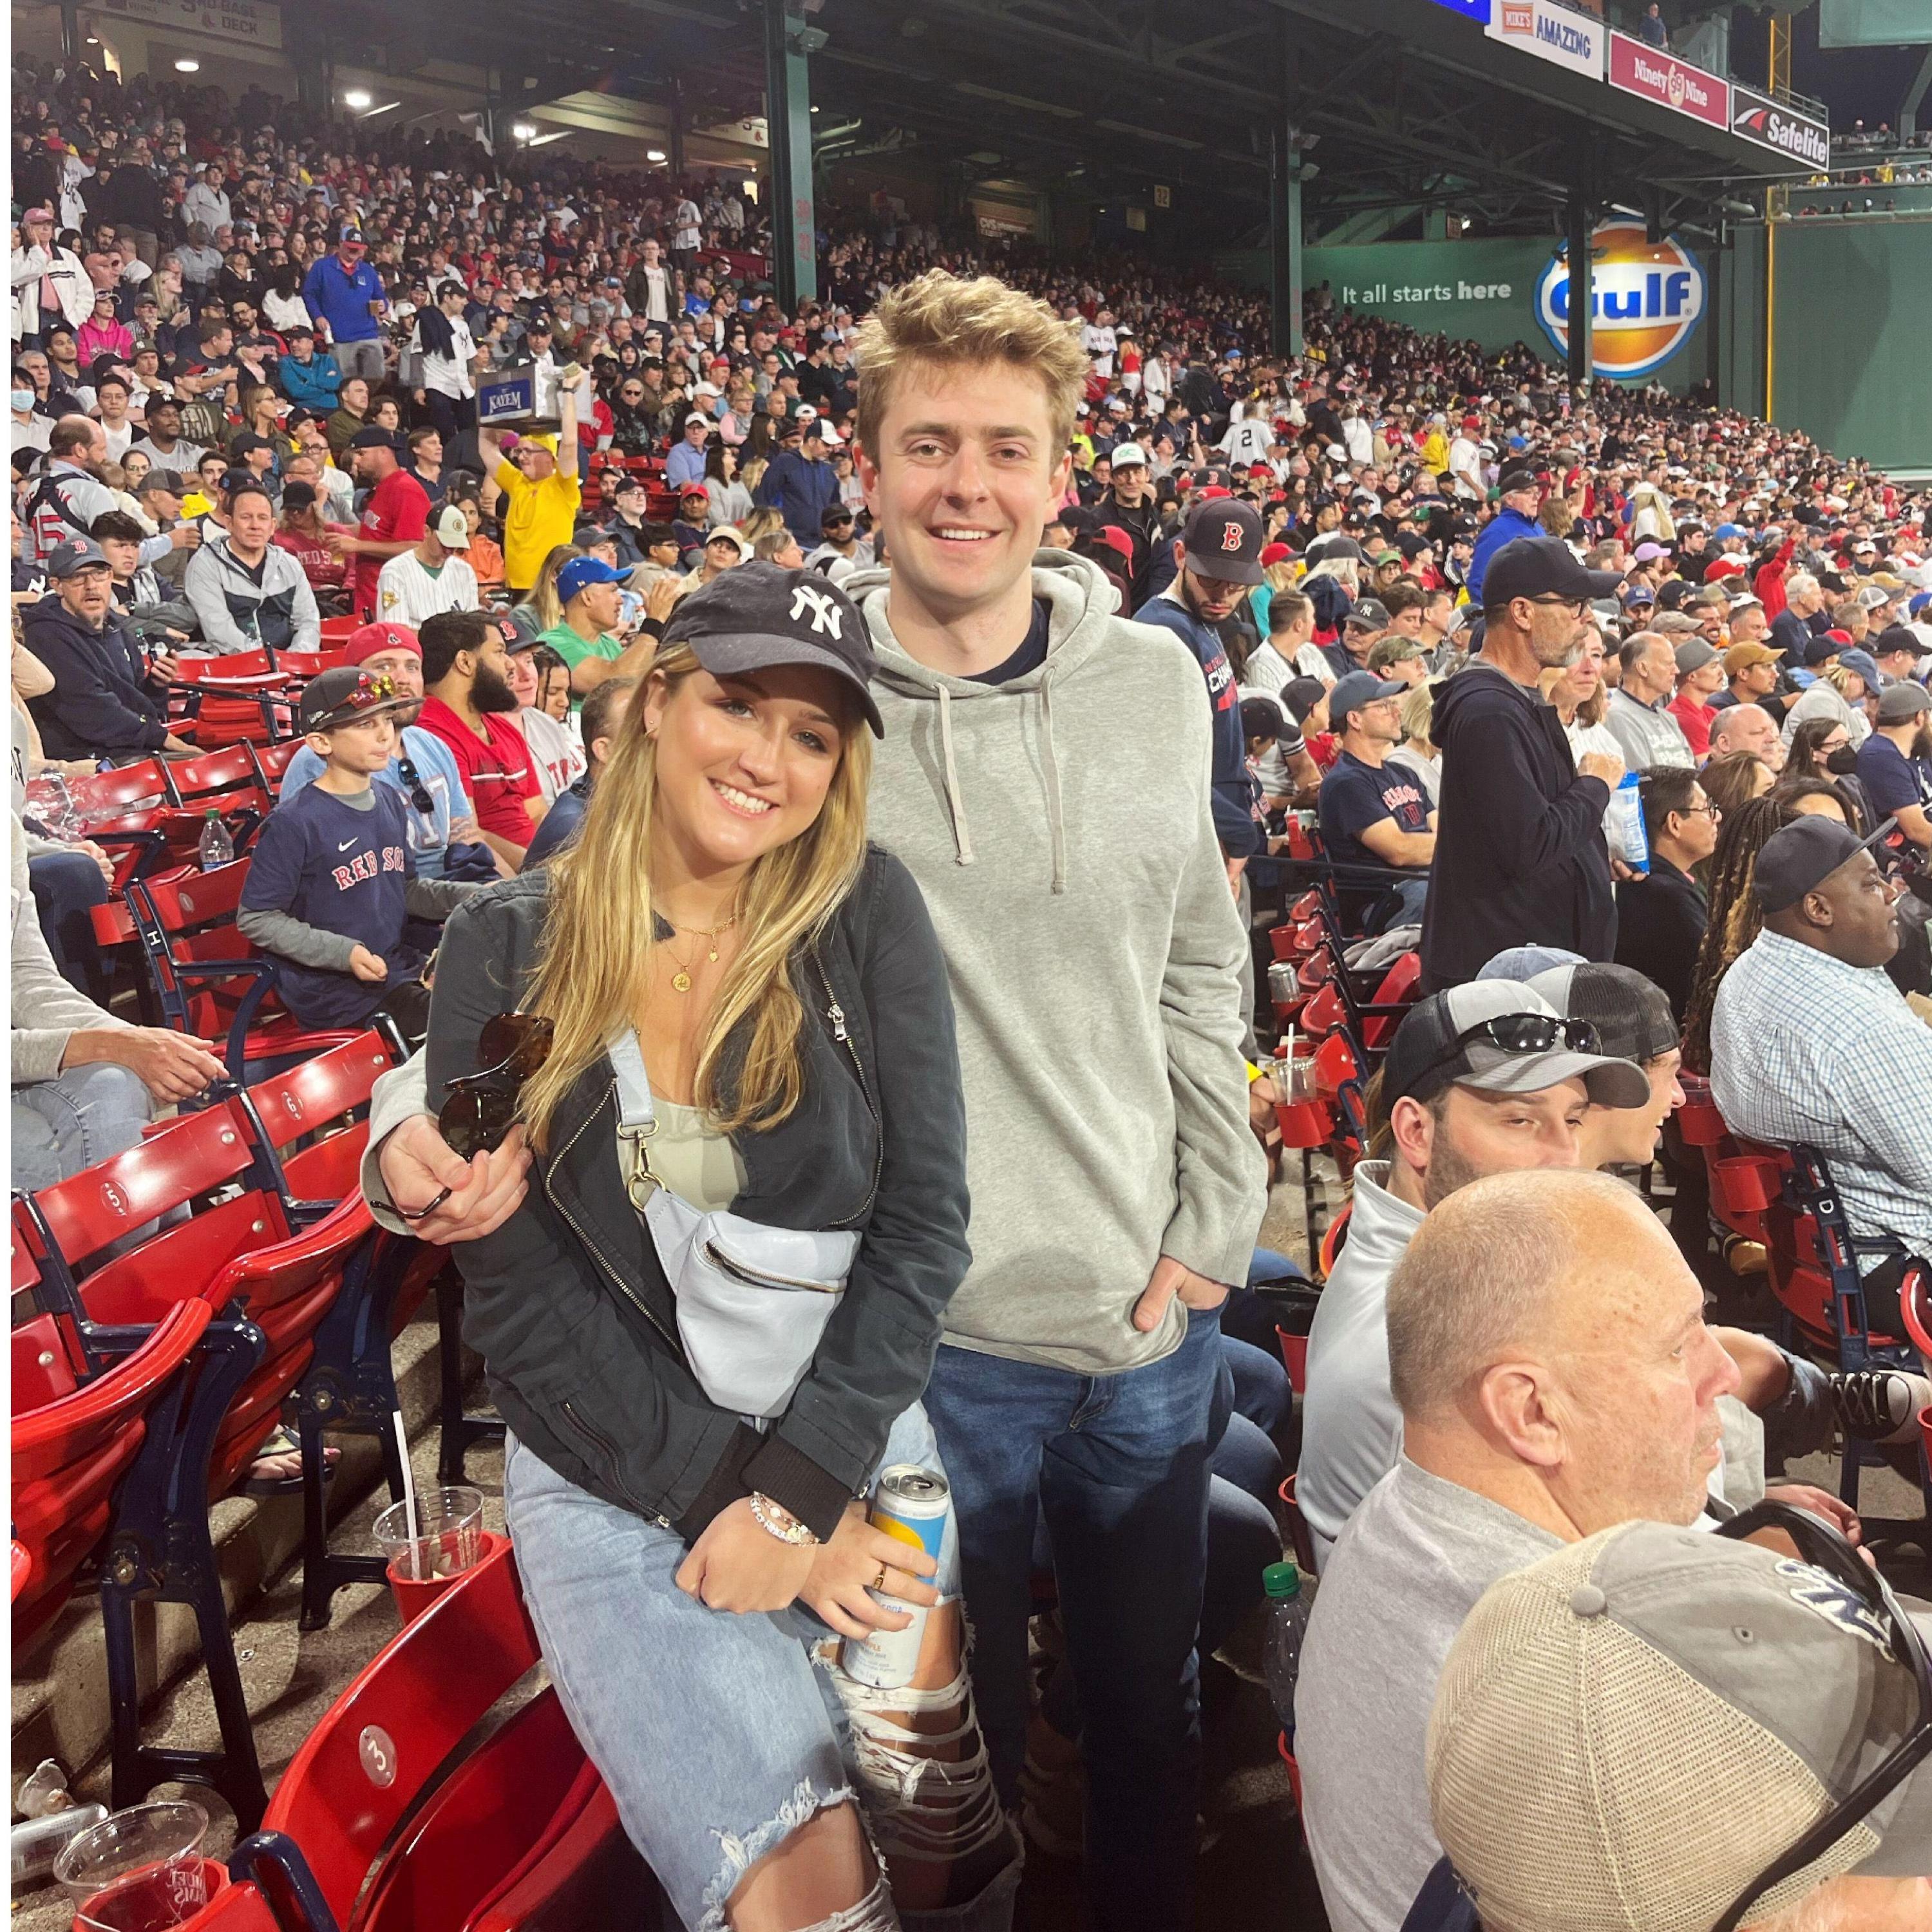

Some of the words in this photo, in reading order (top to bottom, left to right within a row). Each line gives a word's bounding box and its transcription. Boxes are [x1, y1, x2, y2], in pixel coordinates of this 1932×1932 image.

[222, 16, 259, 35] DECK
[1537, 15, 1591, 59] AMAZING
[1634, 57, 1667, 94] Ninety
[1685, 79, 1708, 108] Nine
[1767, 112, 1827, 163] Safelite
[1157, 186, 1169, 204] 32
[1343, 286, 1357, 304] It
[1363, 285, 1387, 303] all
[1393, 284, 1452, 303] starts
[1457, 281, 1511, 300] here
[489, 392, 522, 415] KAYEM
[1242, 429, 1252, 447] 2
[1208, 471, 1219, 484] B
[71, 540, 88, 554] B
[1221, 522, 1244, 551] B
[790, 585, 843, 640] NY
[500, 620, 517, 641] B
[332, 849, 378, 891] RED
[287, 1097, 297, 1112] 6
[107, 1189, 120, 1207] 5
[1819, 1198, 1834, 1214] D
[366, 1739, 388, 1771] 3
